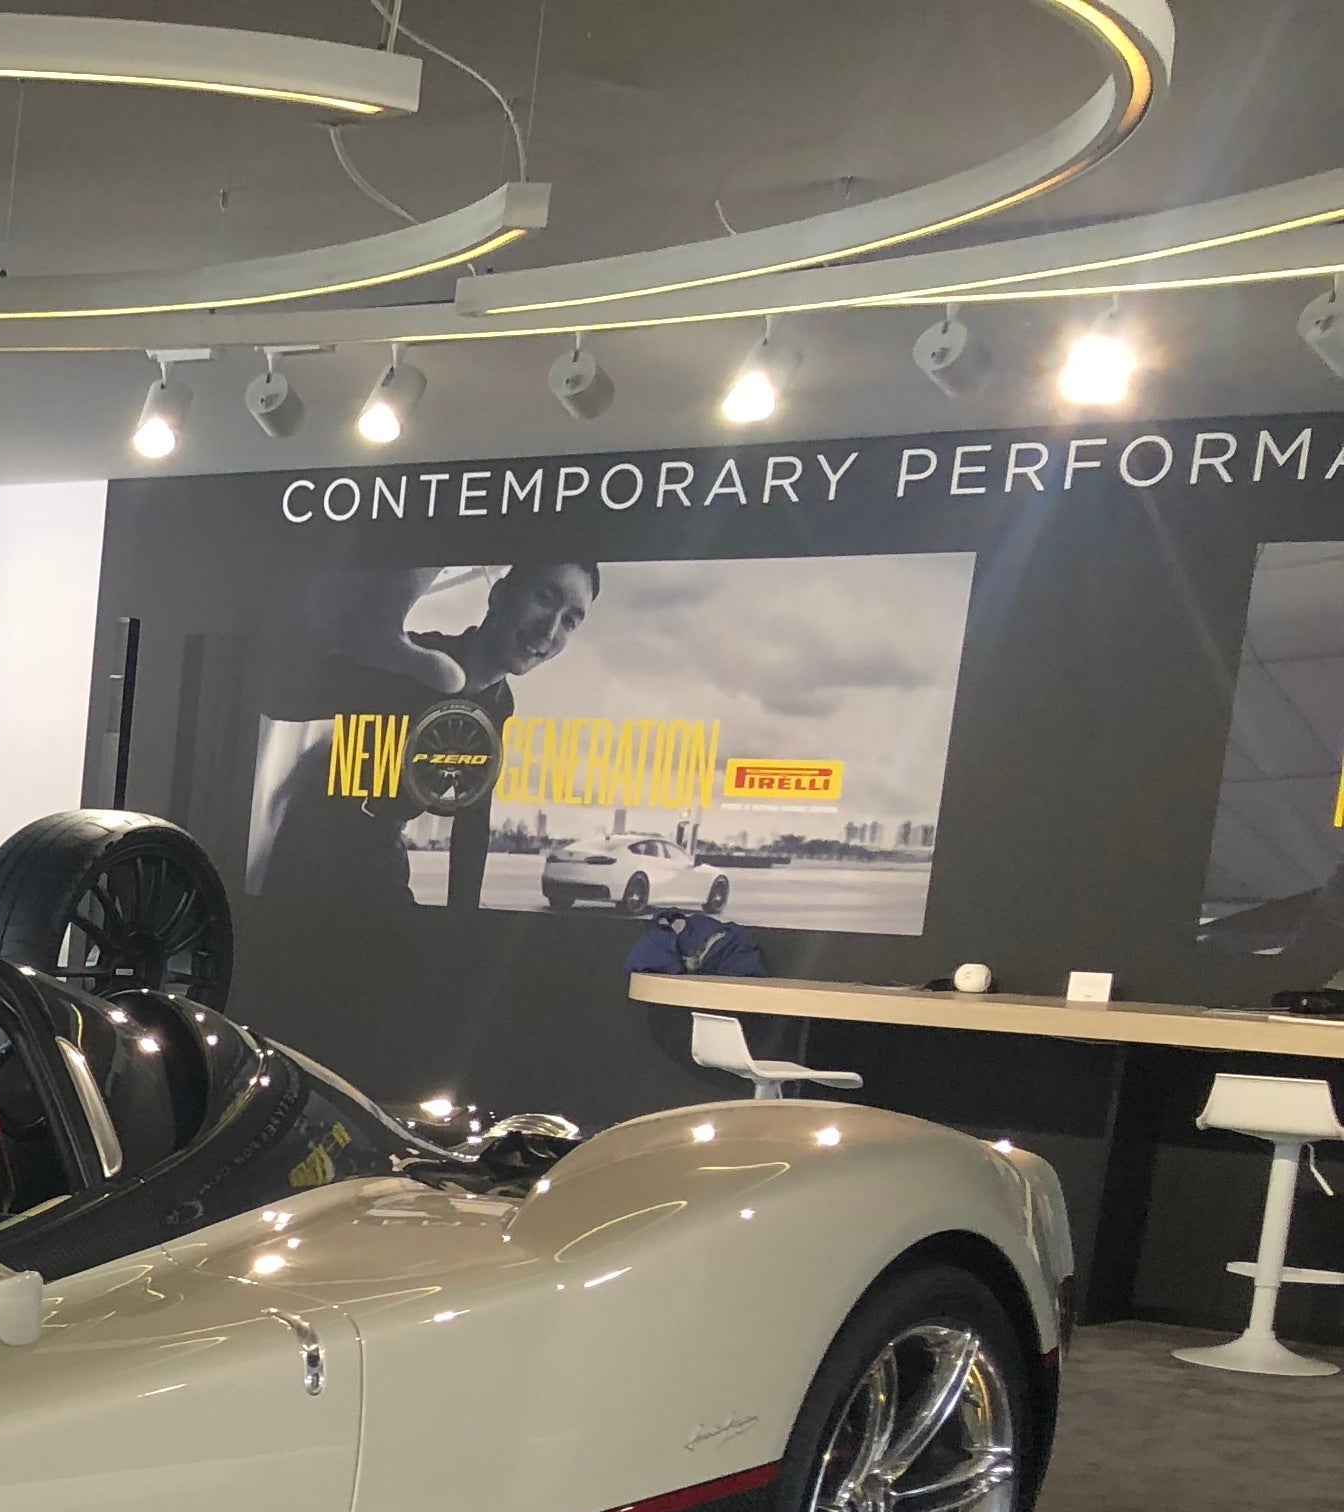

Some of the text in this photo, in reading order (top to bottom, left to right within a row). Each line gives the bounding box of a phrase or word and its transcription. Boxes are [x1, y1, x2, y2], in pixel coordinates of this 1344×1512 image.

[281, 452, 860, 523] CONTEMPORARY
[327, 713, 720, 810] NEW GENERATION
[734, 766, 833, 791] PIRELLI
